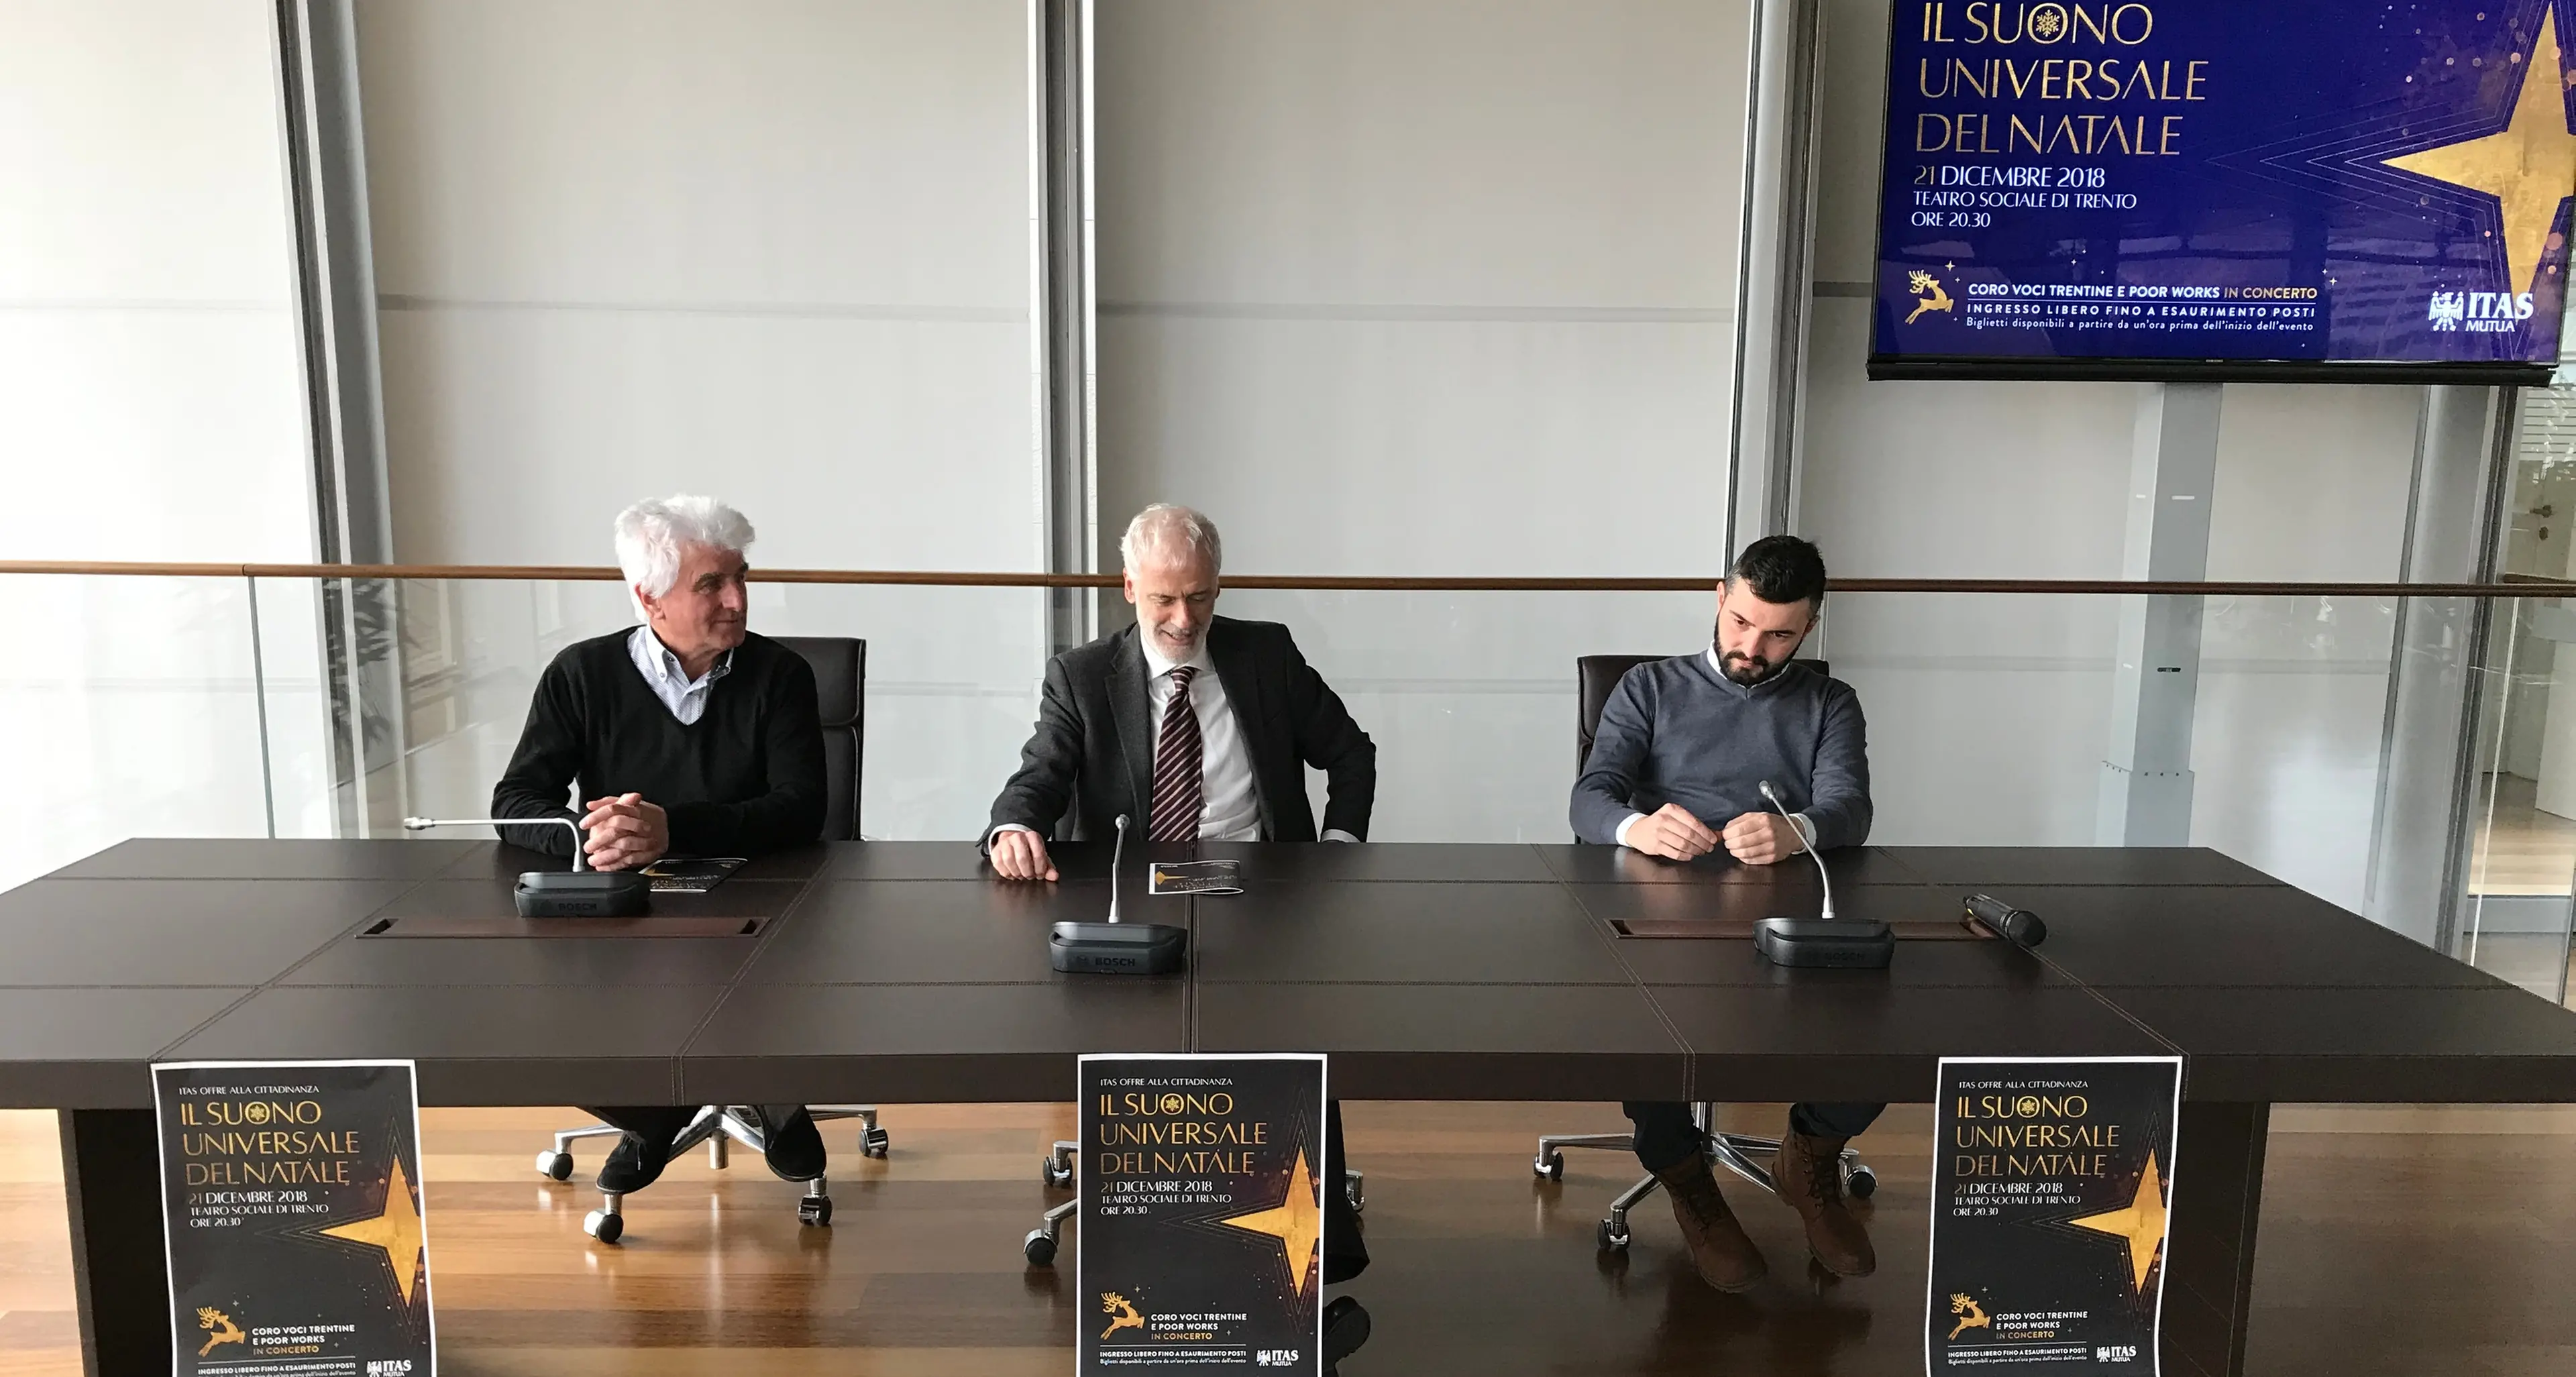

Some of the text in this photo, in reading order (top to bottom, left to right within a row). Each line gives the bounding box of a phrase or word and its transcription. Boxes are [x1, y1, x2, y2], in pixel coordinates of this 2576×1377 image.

[1923, 1, 2153, 45] IL SUONO
[1920, 58, 2209, 101] UNIVERSALE
[1916, 113, 2183, 155] DEL NATALE
[1914, 165, 2105, 188] 21 DICEMBRE 2018
[1913, 190, 2137, 209] TEATRO SOCIALE DI TRENTO
[1911, 211, 1991, 227] ORE 20.30
[1968, 284, 2318, 298] CORO VOCI TRENTINE E POOR WORKS IN CONCERTO
[1967, 304, 2314, 317] INGRESSO LIBERO FINO A ESAURIMENTO POSTI
[2467, 292, 2534, 319] ITAS
[1966, 317, 2008, 329] Biglietti
[2012, 318, 2065, 329] disponibili
[2079, 319, 2113, 331] partire
[2118, 320, 2129, 329] da
[2133, 320, 2165, 329] un'ora
[2169, 321, 2198, 331] prima
[2203, 321, 2252, 330] dell'inizio
[2257, 321, 2313, 330] dell'evento
[2465, 321, 2515, 332] MUTUA
[1095, 958, 1135, 966] BOSCH
[179, 1087, 197, 1095] ITAS
[200, 1087, 226, 1095] OFFRE
[229, 1086, 252, 1094] ALLA
[1100, 1093, 1233, 1115] IL SUONO
[1957, 1095, 2088, 1118] IL SUONO
[180, 1101, 321, 1125] IL SUONO
[1100, 1122, 1267, 1145] UNIVERSALE
[1957, 1125, 2120, 1148] UNIVERSALE
[183, 1131, 360, 1156] UNIVERSALE
[1100, 1152, 1254, 1174] DEL NATALE
[1955, 1154, 2107, 1176] DEL NATALE
[186, 1161, 350, 1185] DEL NATALE
[1101, 1180, 1212, 1193] 21 DICEMBRE 2018
[1954, 1182, 2063, 1194] 21 DICEMBRE 2018
[189, 1191, 307, 1205] 21 DICEMBRE 2018
[1102, 1195, 1137, 1203] TEATRO
[1140, 1195, 1179, 1203] SOCIALE
[1182, 1195, 1192, 1203] DI
[1955, 1197, 1989, 1205] TEATRO
[1992, 1197, 2029, 1205] SOCIALE
[2032, 1196, 2042, 1204] DI
[191, 1207, 229, 1215] TEATRO
[231, 1205, 274, 1215] SOCIALE
[277, 1205, 287, 1213] DI
[1101, 1206, 1147, 1215] ORE 20.30
[1953, 1207, 1998, 1216] ORE 20.30
[191, 1217, 241, 1228] ORE 20.30
[252, 1325, 355, 1335] CORO VOCI TRENTINE
[261, 1337, 288, 1345] POOR
[290, 1335, 325, 1343] WORKS
[266, 1345, 319, 1354] CONCERTO
[1272, 1350, 1299, 1361] ITAS
[2111, 1346, 2137, 1357] ITAS
[285, 1363, 335, 1371] ESAURIMENTO
[383, 1360, 411, 1372] ITAS
